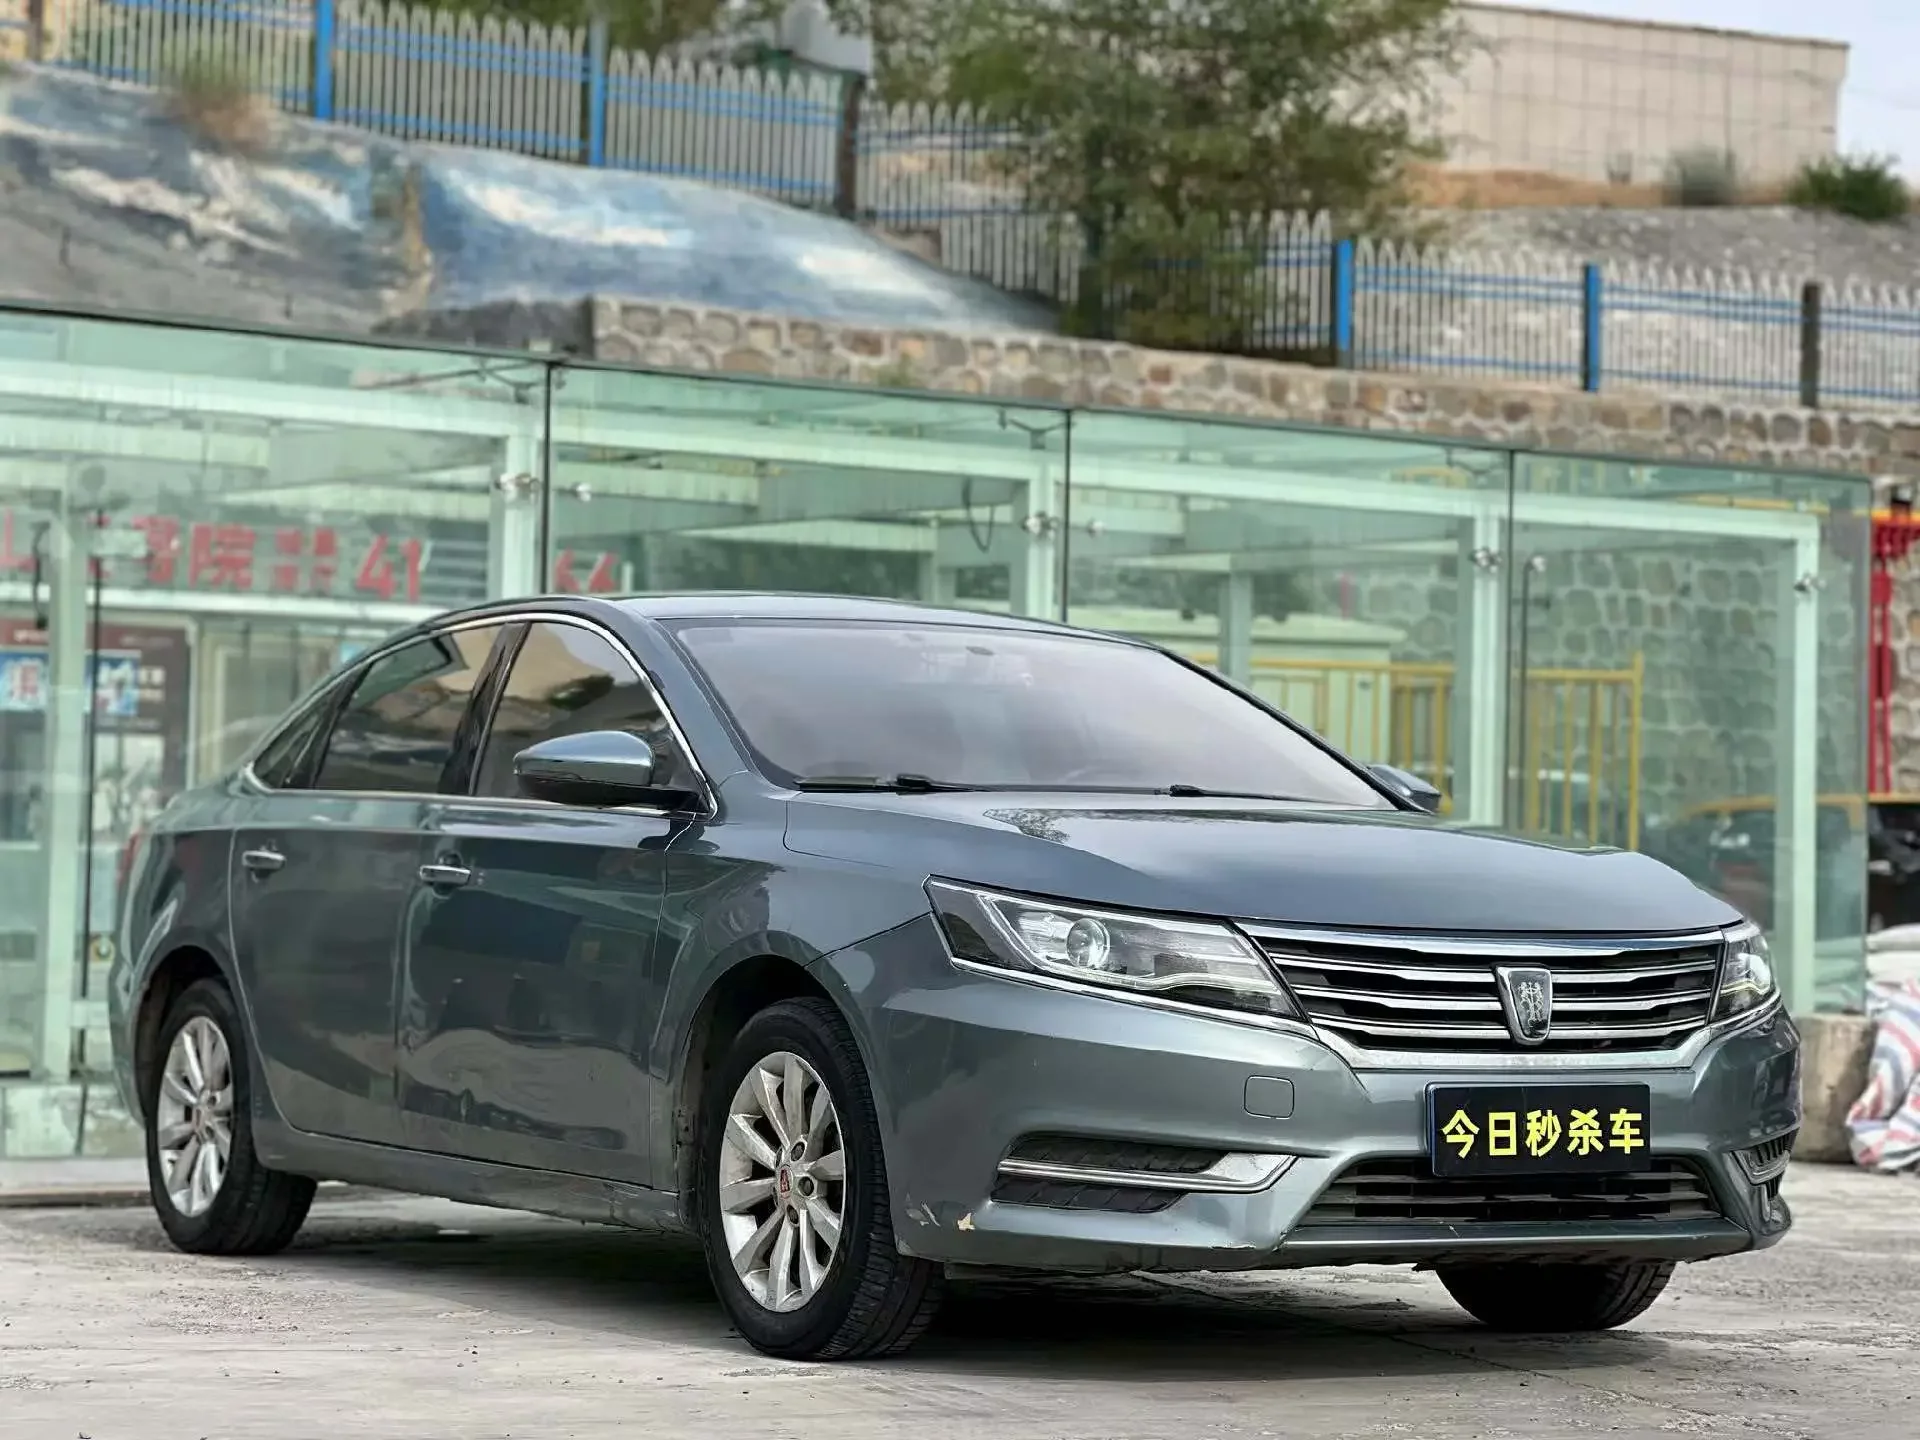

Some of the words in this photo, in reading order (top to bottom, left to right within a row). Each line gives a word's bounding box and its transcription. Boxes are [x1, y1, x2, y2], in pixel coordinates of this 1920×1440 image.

[1441, 1108, 1645, 1159] 今日秒杀车
